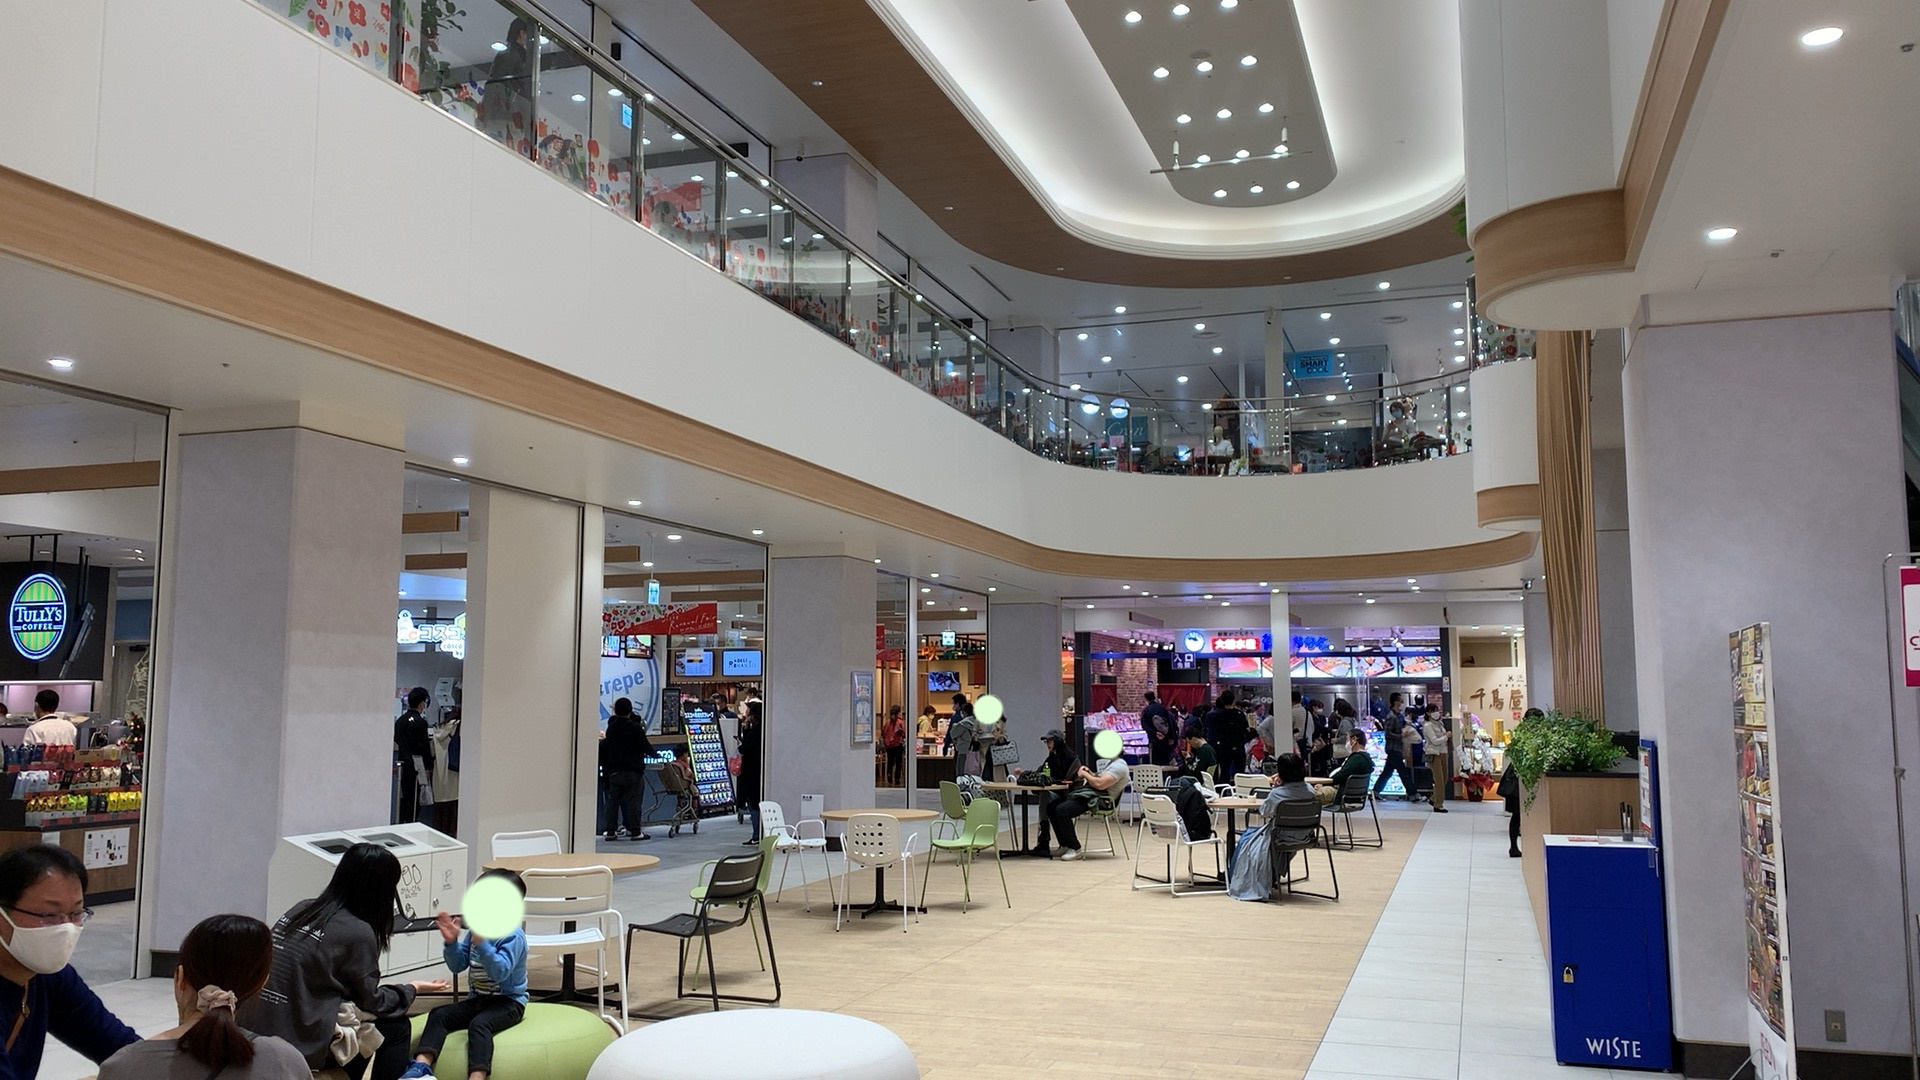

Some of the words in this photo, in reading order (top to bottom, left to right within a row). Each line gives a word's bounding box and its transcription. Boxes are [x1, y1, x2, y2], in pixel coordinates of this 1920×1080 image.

[22, 623, 53, 631] COFFEE
[1173, 653, 1194, 662] 入口
[600, 671, 645, 696] repe
[1585, 1036, 1642, 1060] WISTE
